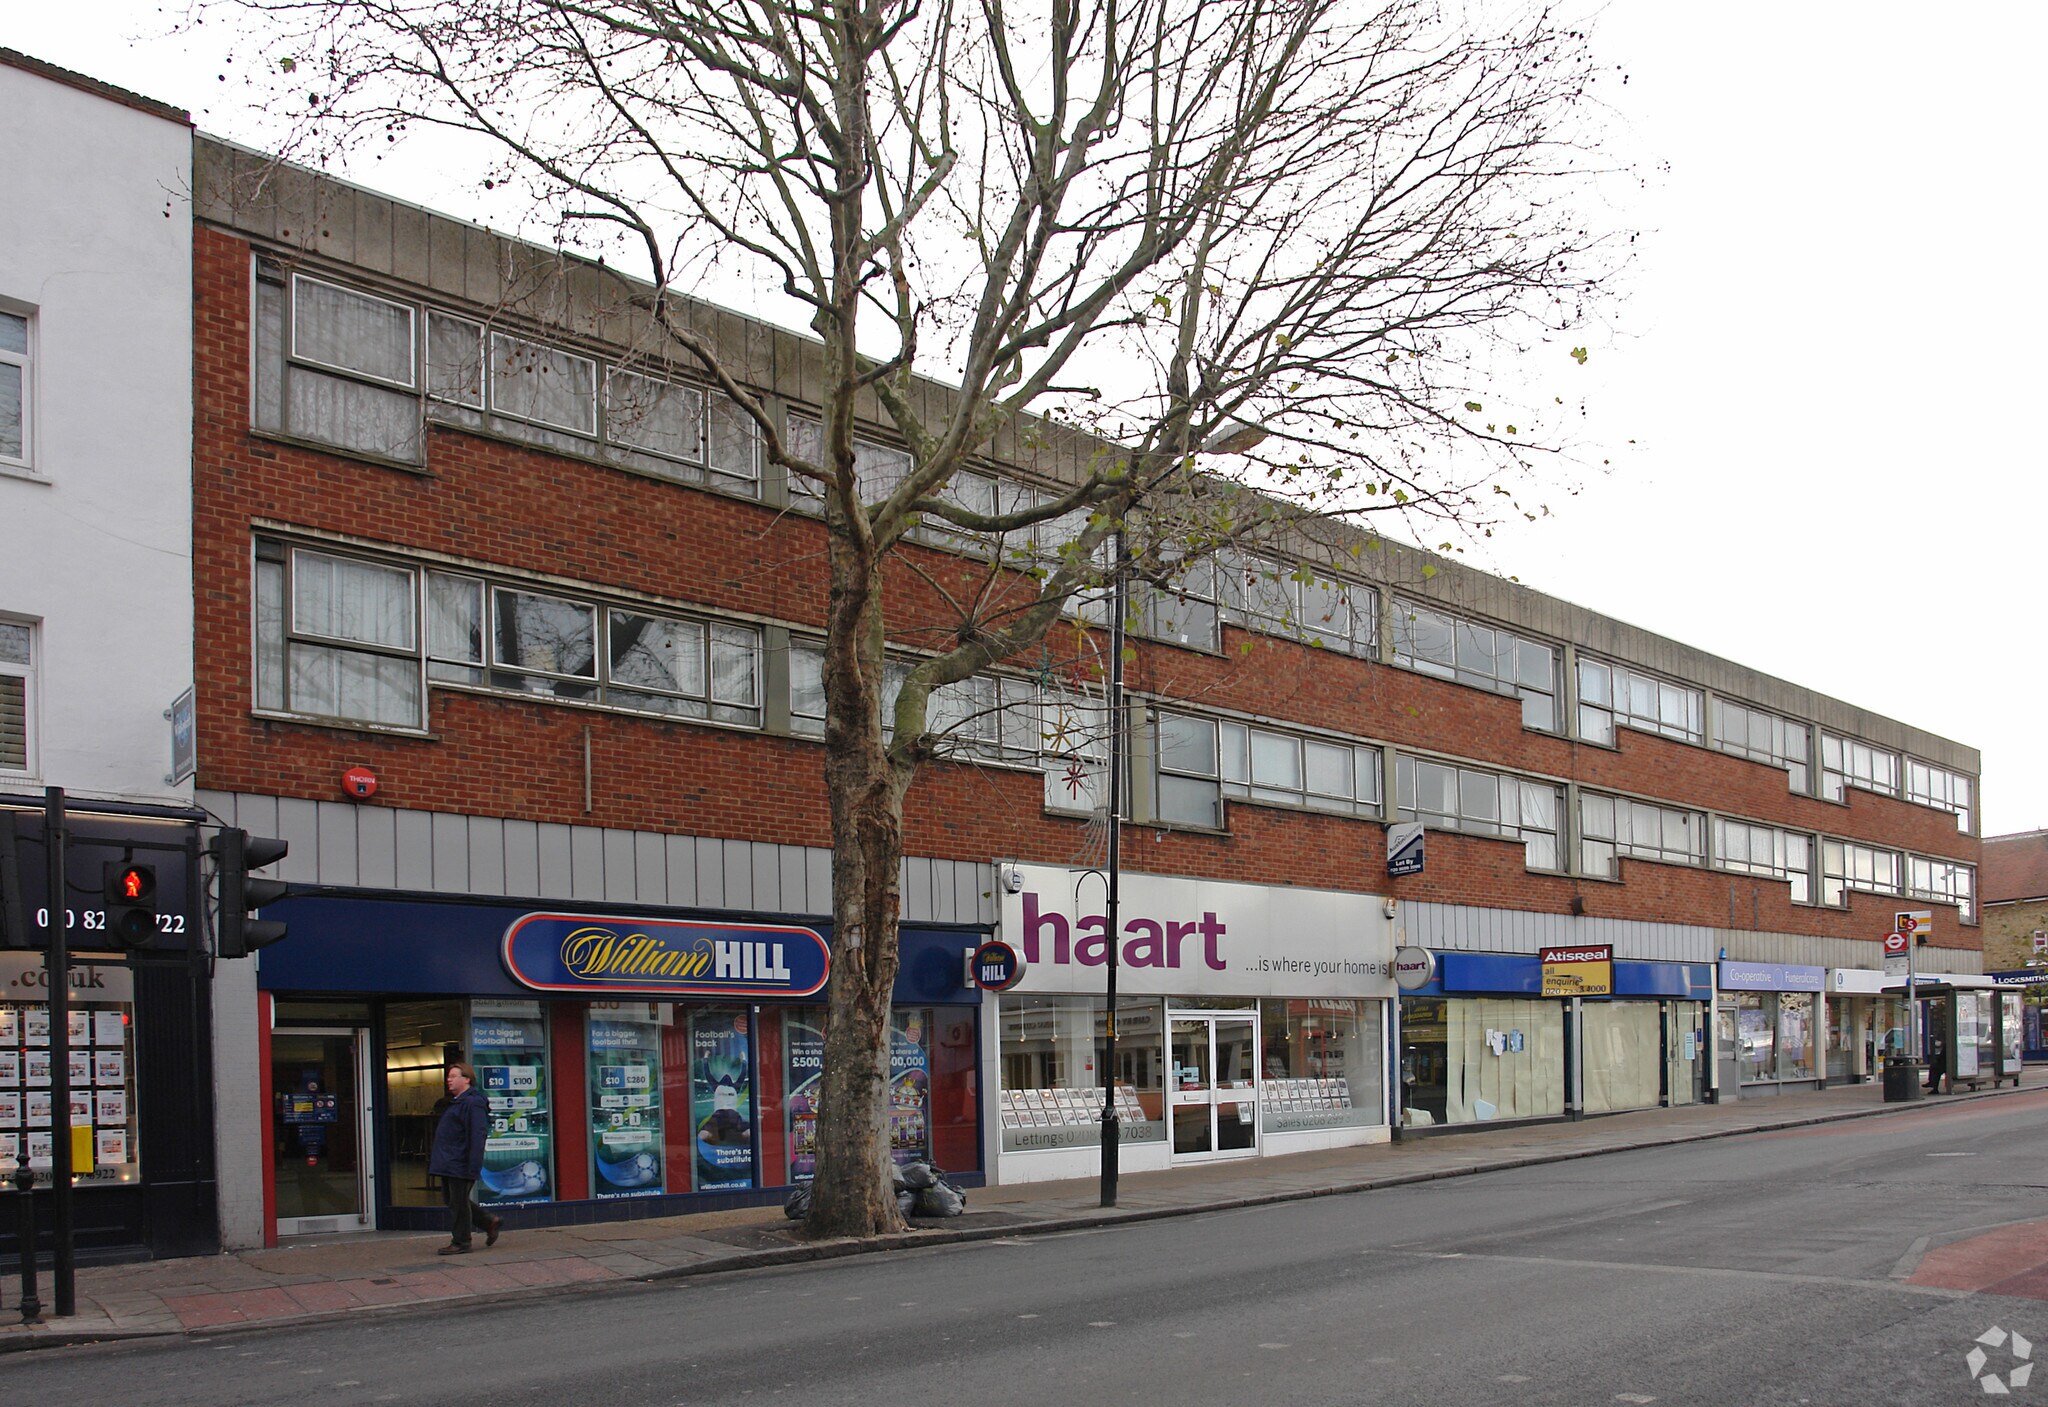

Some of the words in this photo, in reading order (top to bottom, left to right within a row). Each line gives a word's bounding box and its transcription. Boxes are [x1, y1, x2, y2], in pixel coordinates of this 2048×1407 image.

[349, 775, 376, 784] THORN
[1907, 920, 1914, 929] S
[1022, 892, 1227, 971] haart
[561, 927, 715, 978] William
[715, 940, 791, 980] HILL
[1272, 956, 1311, 973] where
[1313, 961, 1341, 977] your
[1344, 959, 1376, 974] home
[1378, 960, 1388, 975] is
[1396, 961, 1426, 971] haart
[982, 964, 1006, 981] HILL
[1545, 967, 1555, 975] all
[1730, 968, 1772, 983] Co-operative
[1785, 971, 1819, 984] Funeralcare
[1546, 976, 1583, 986] enquiries
[1545, 987, 1560, 995] 020
[1586, 985, 1607, 993] 4000
[474, 1028, 487, 1036] For
[496, 1028, 522, 1038] bigger
[611, 1030, 636, 1038] bigger
[695, 1030, 735, 1039] Football's
[474, 1037, 506, 1045] football
[507, 1037, 524, 1045] thrill
[592, 1038, 620, 1046] football
[621, 1038, 638, 1046] thrill
[695, 1039, 718, 1048] back
[488, 1077, 504, 1086] £10
[513, 1077, 533, 1085] £100
[605, 1077, 620, 1085] £10
[614, 1116, 620, 1124] 3
[1276, 1118, 1300, 1129] Sales
[498, 1121, 504, 1129] 2
[1014, 1132, 1064, 1147] Lettings
[1124, 1126, 1153, 1139] 7038
[716, 1148, 742, 1156] There's
[716, 1156, 751, 1164] substitute
[597, 1192, 620, 1200] There's
